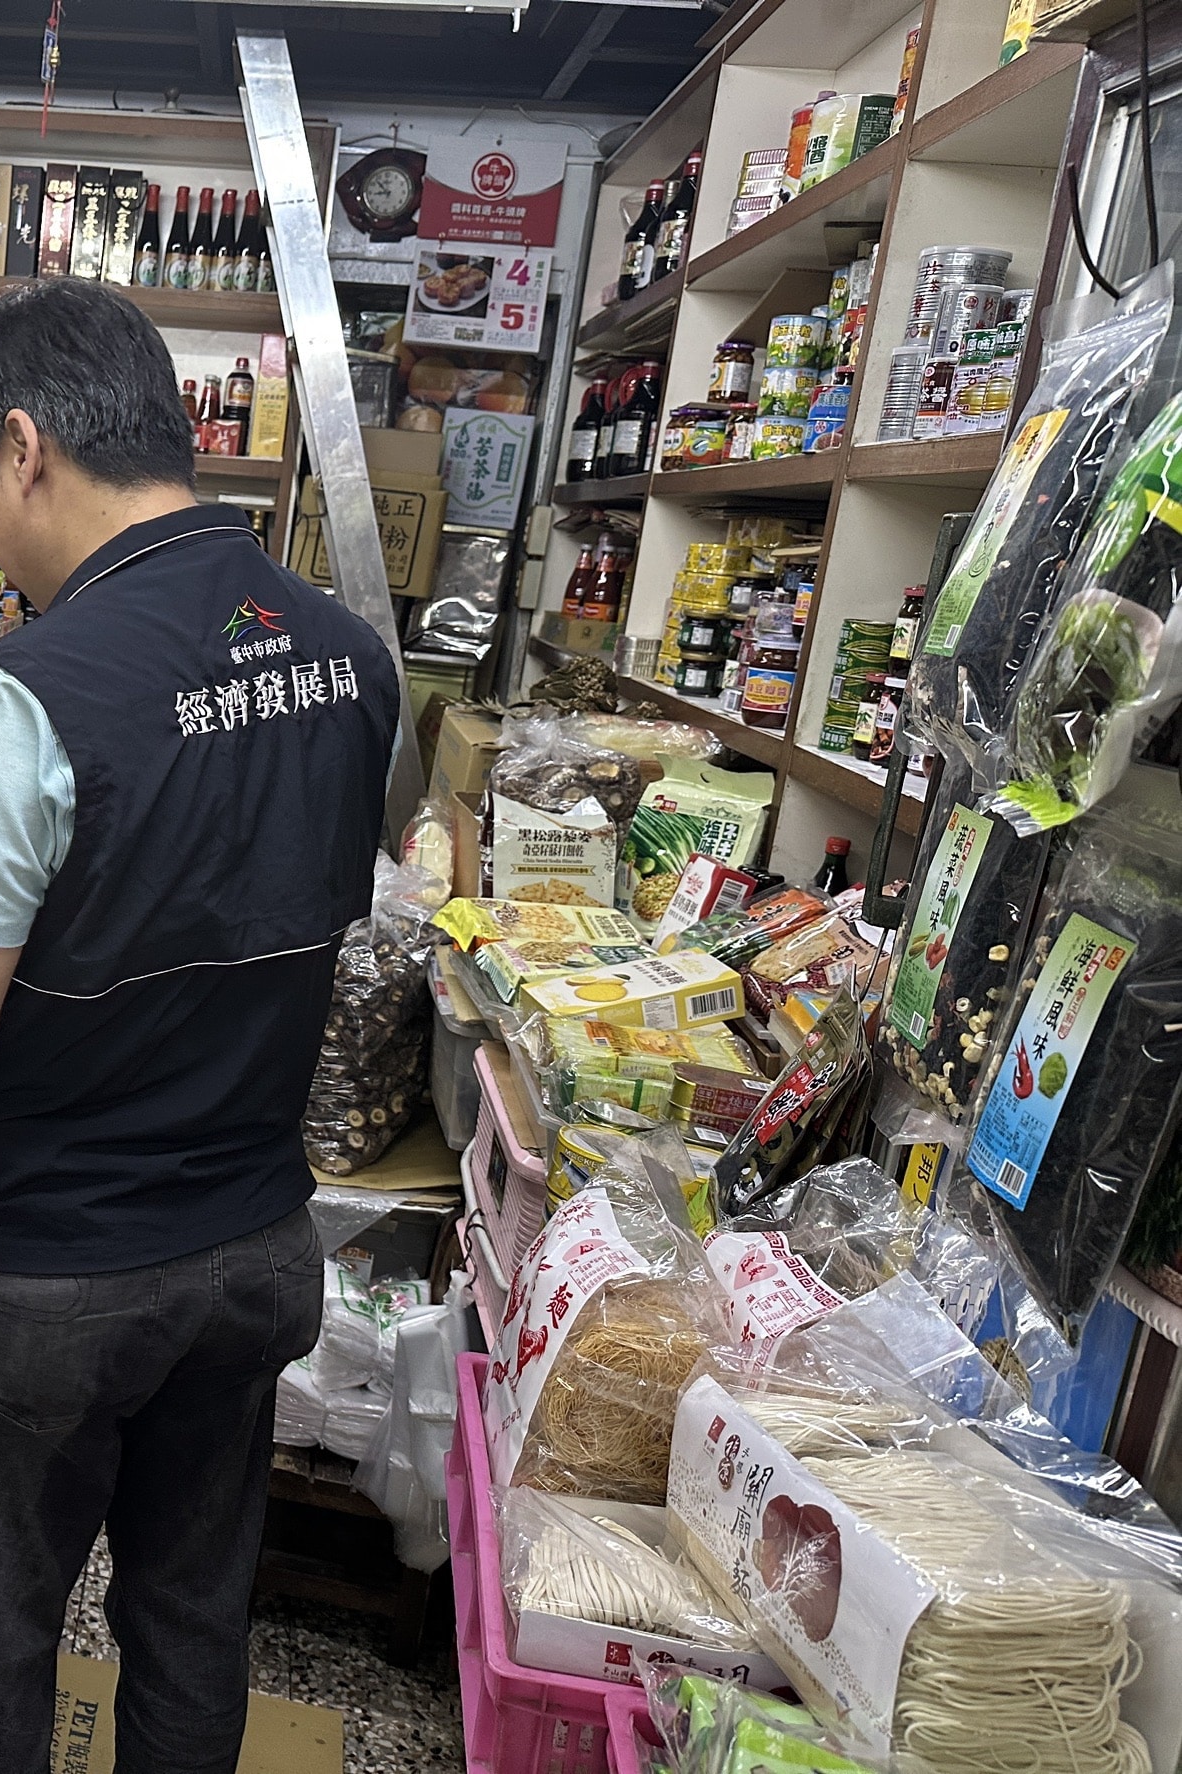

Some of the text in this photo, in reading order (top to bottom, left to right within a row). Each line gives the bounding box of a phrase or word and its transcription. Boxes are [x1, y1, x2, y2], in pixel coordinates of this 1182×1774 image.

[506, 259, 531, 287] 4
[500, 304, 525, 331] 5
[466, 437, 493, 501] 苦茶油
[229, 634, 292, 665] 臺中市政府
[174, 655, 359, 737] 經濟發展局
[518, 829, 592, 843] 黑松露藜麥
[698, 820, 723, 854] 塩味
[1033, 939, 1096, 1060] 海鮮風味
